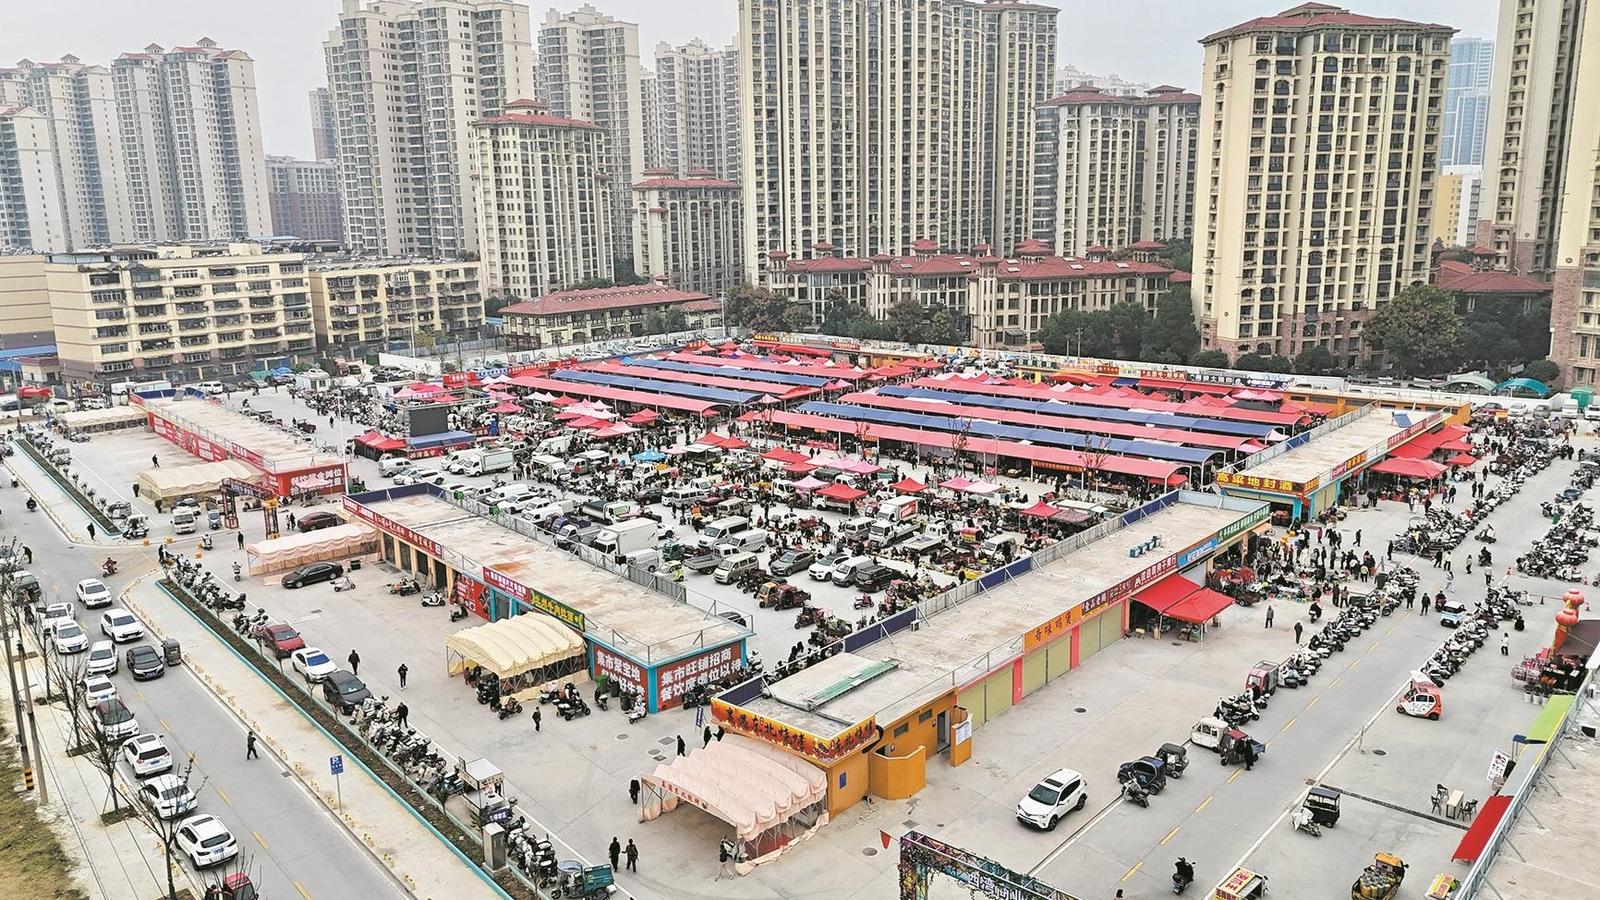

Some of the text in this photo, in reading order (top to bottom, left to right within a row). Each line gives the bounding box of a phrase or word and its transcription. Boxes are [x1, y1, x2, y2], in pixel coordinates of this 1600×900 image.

[1217, 471, 1292, 491] 高粱地封酒
[597, 651, 640, 681] 集市聚宝地
[661, 648, 732, 687] 集市旺铺招商
